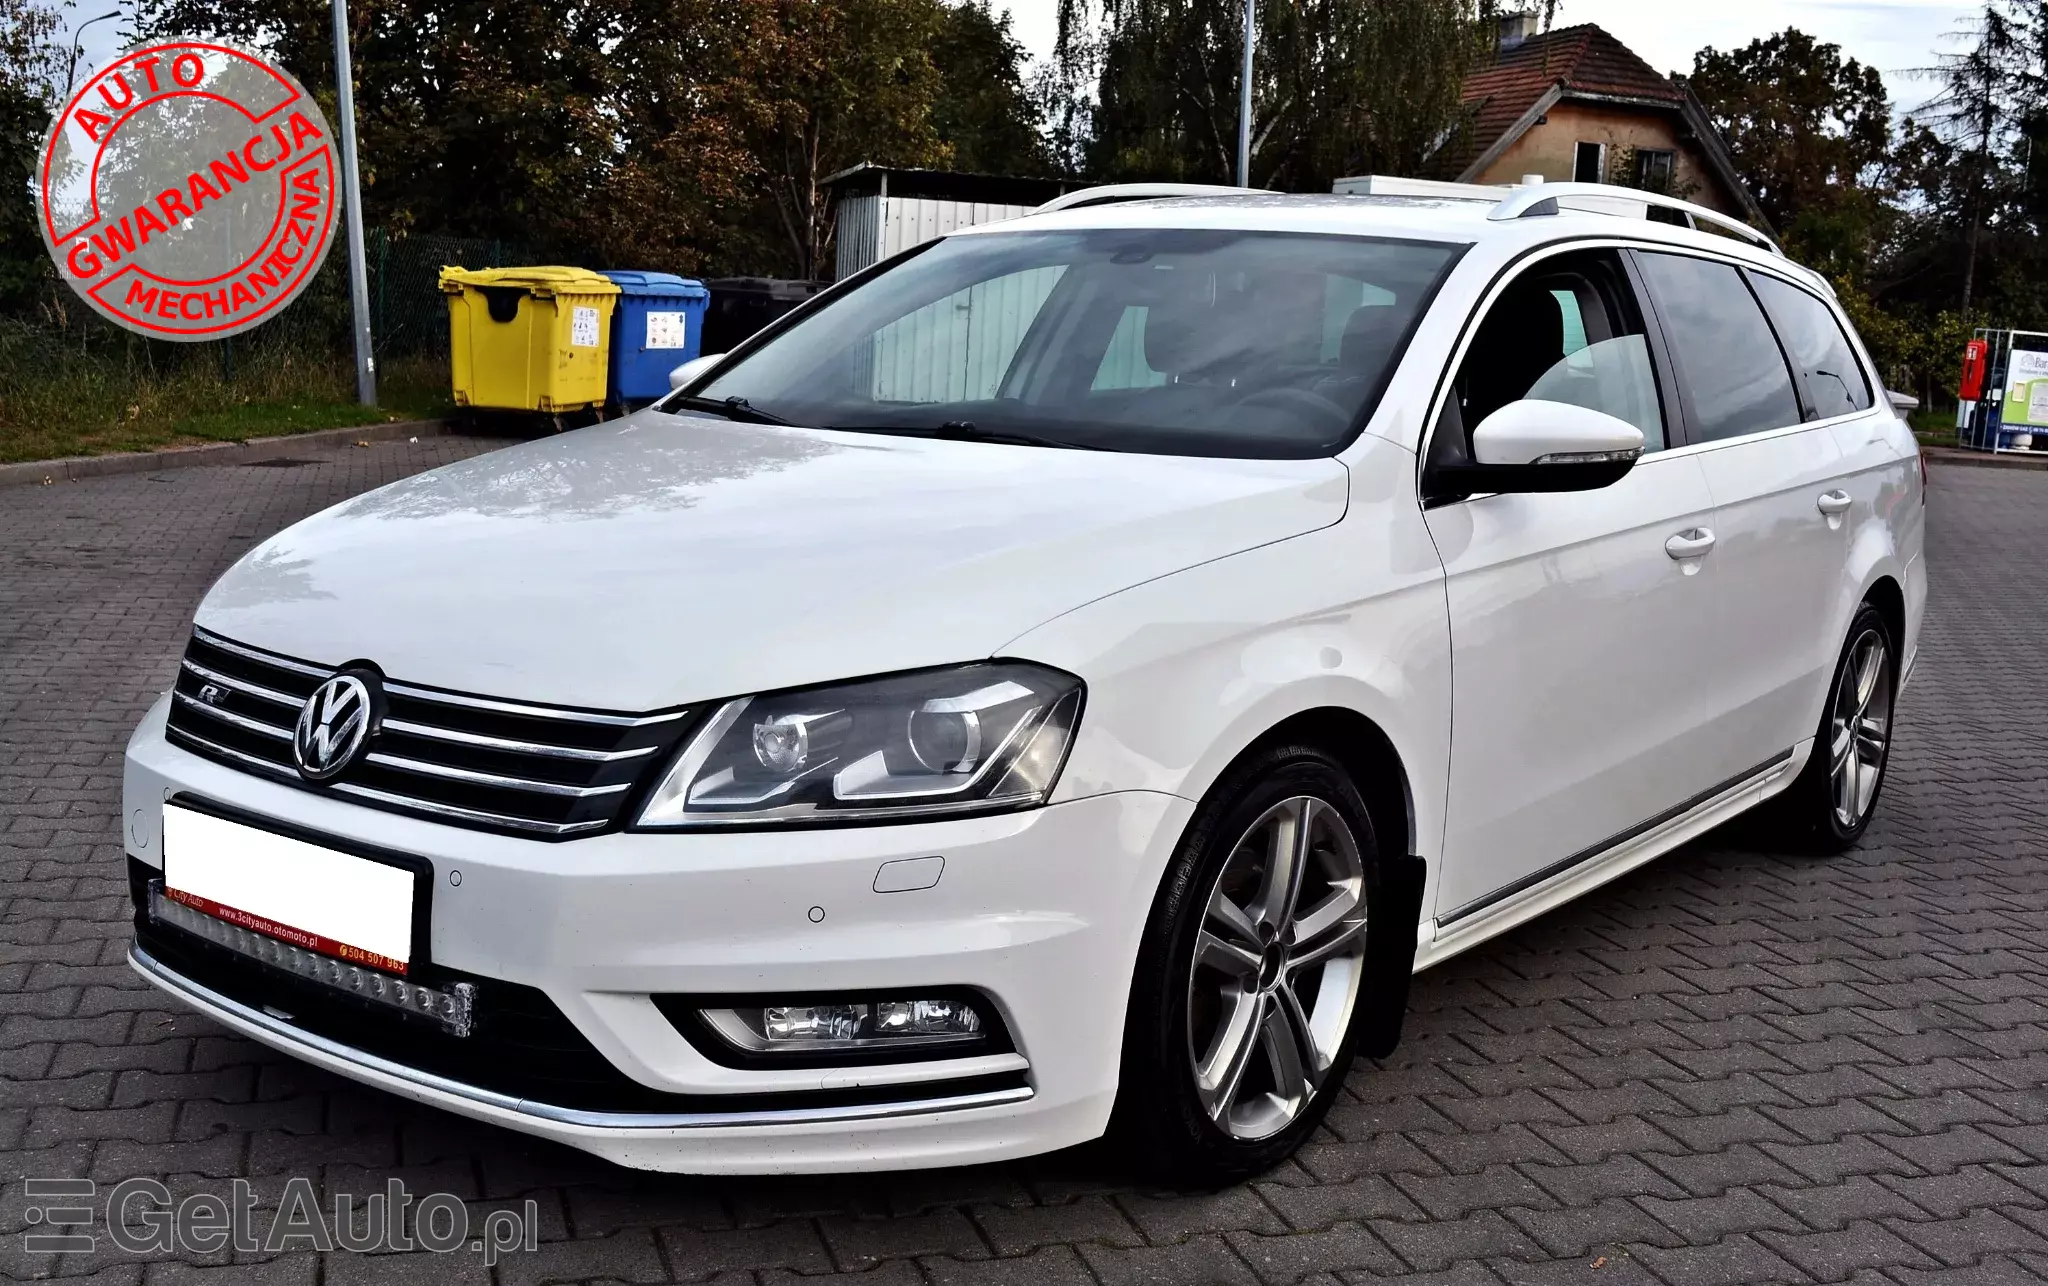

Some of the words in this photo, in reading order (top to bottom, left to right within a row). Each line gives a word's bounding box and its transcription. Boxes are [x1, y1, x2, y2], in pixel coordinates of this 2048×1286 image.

[219, 907, 318, 947] www.3cityauto.otomoto.pl
[348, 947, 365, 960] 504
[367, 952, 384, 965] 507
[387, 958, 404, 971] 963
